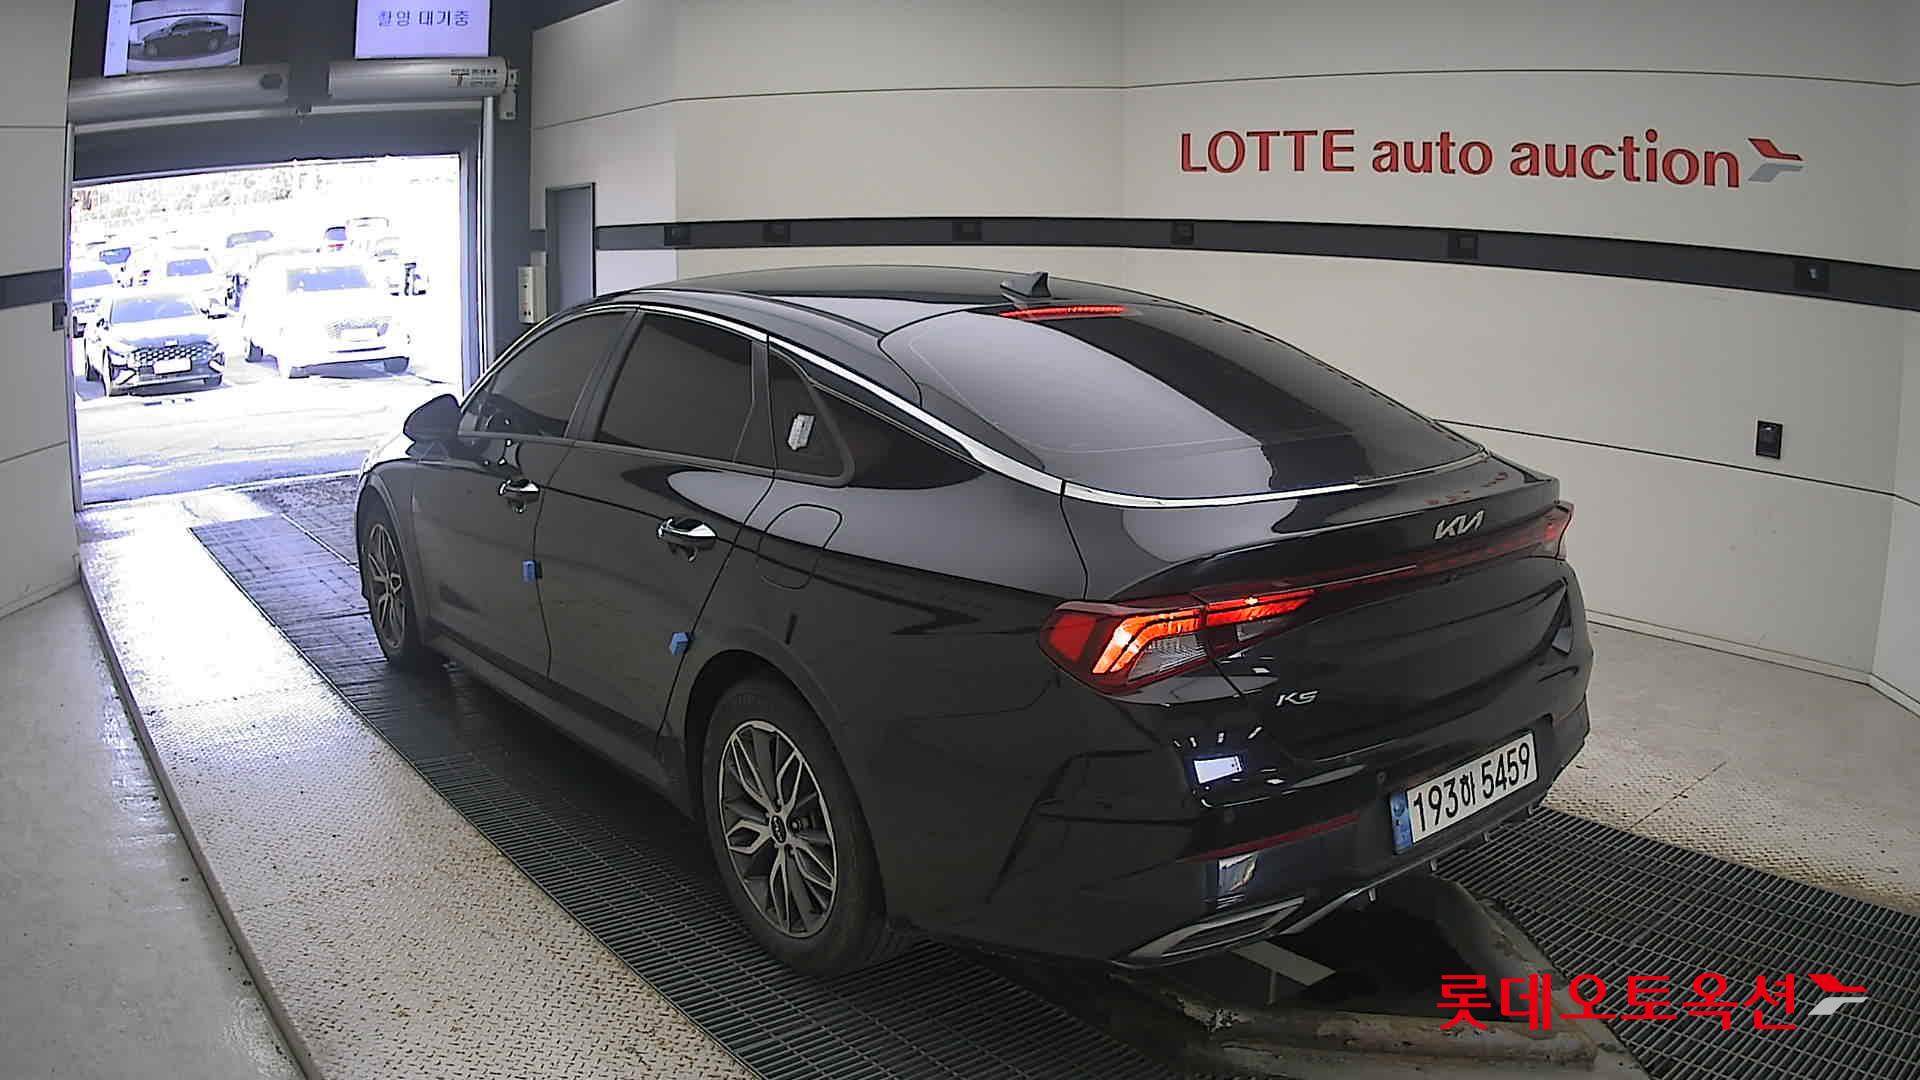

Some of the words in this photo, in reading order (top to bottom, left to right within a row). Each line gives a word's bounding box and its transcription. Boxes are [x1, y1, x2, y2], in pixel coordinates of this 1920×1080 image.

[419, 10, 468, 27] 대기중
[1180, 129, 1355, 173] LOTTE
[1372, 131, 1494, 174] auto
[1510, 129, 1740, 188] auction
[1275, 690, 1319, 706] K5
[1413, 772, 1477, 832] 193하
[1481, 742, 1530, 799] 5459
